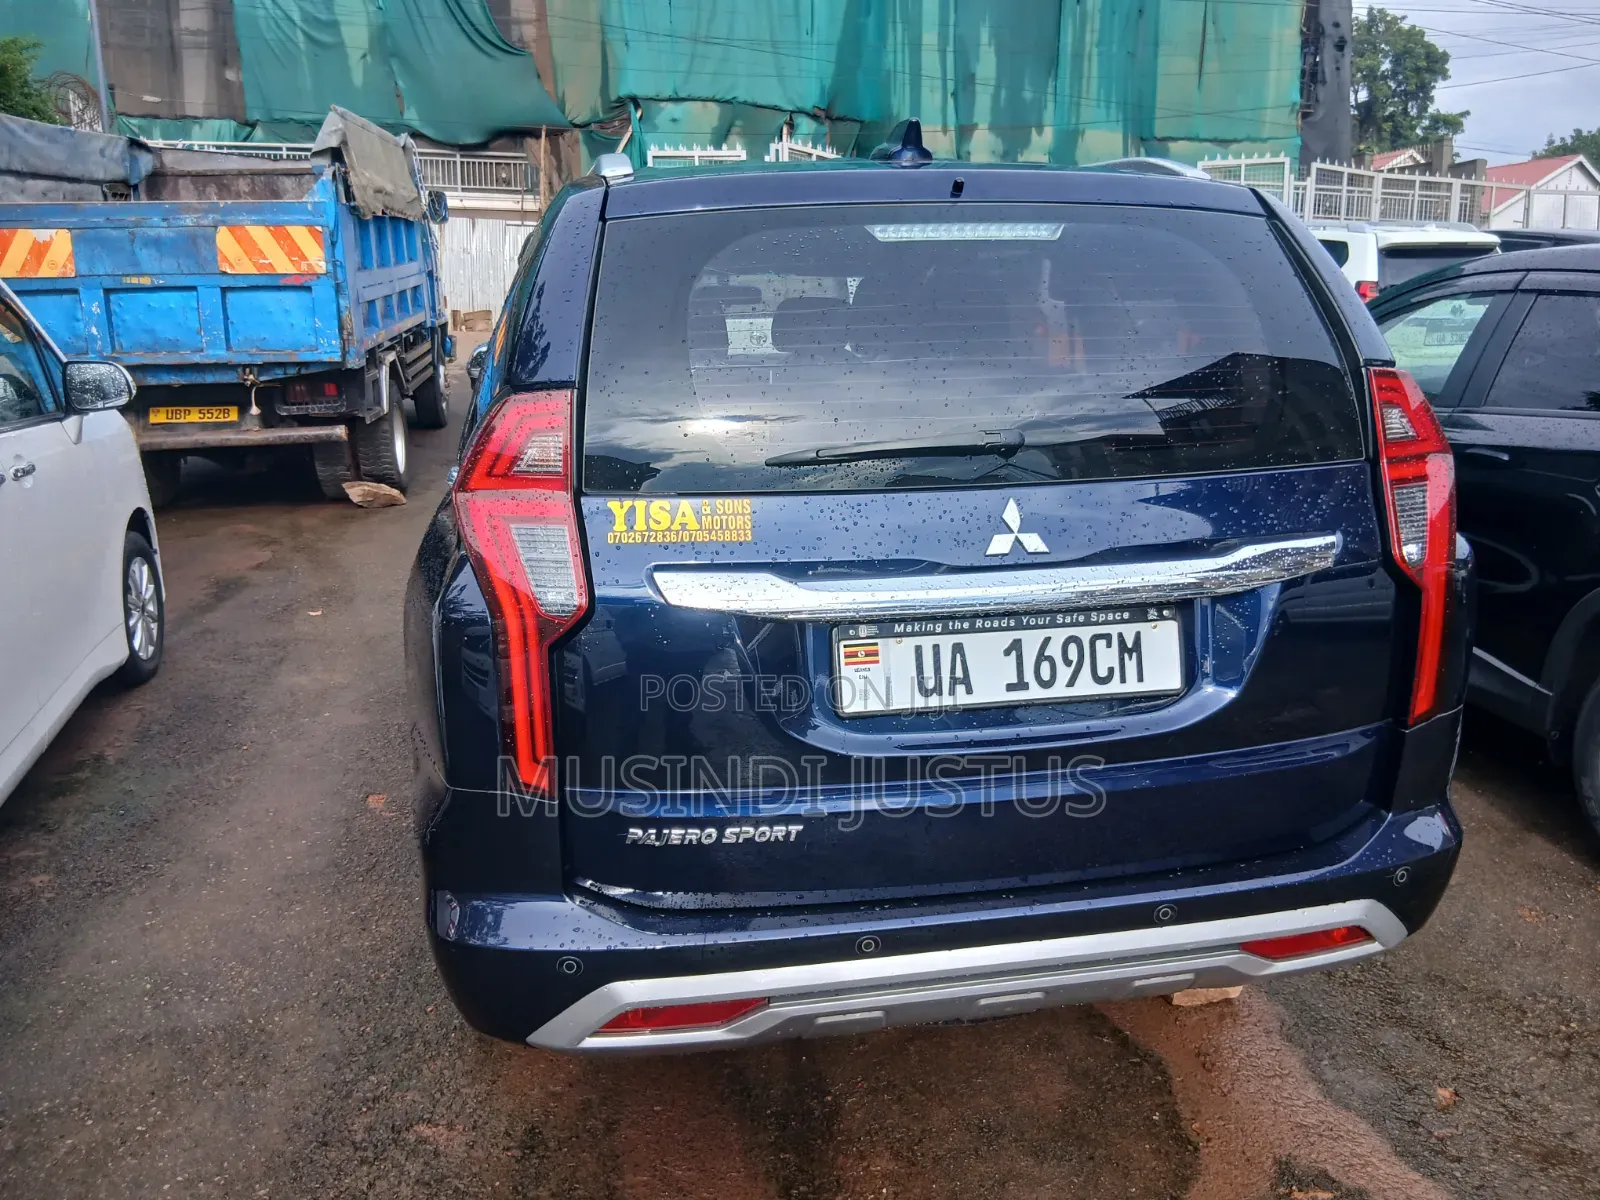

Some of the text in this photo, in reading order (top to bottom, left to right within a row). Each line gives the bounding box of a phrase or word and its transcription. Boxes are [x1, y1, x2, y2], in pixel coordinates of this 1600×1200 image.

[166, 408, 230, 420] UBP 552B
[607, 498, 752, 532] YISA & SONS
[701, 515, 752, 531] MOTORS
[607, 530, 752, 544] 0702672836/0705458833
[894, 611, 1130, 634] Making the Roads Your Safe Space
[914, 630, 1145, 699] UA 169CM
[625, 825, 804, 847] PAJERO SPORT
